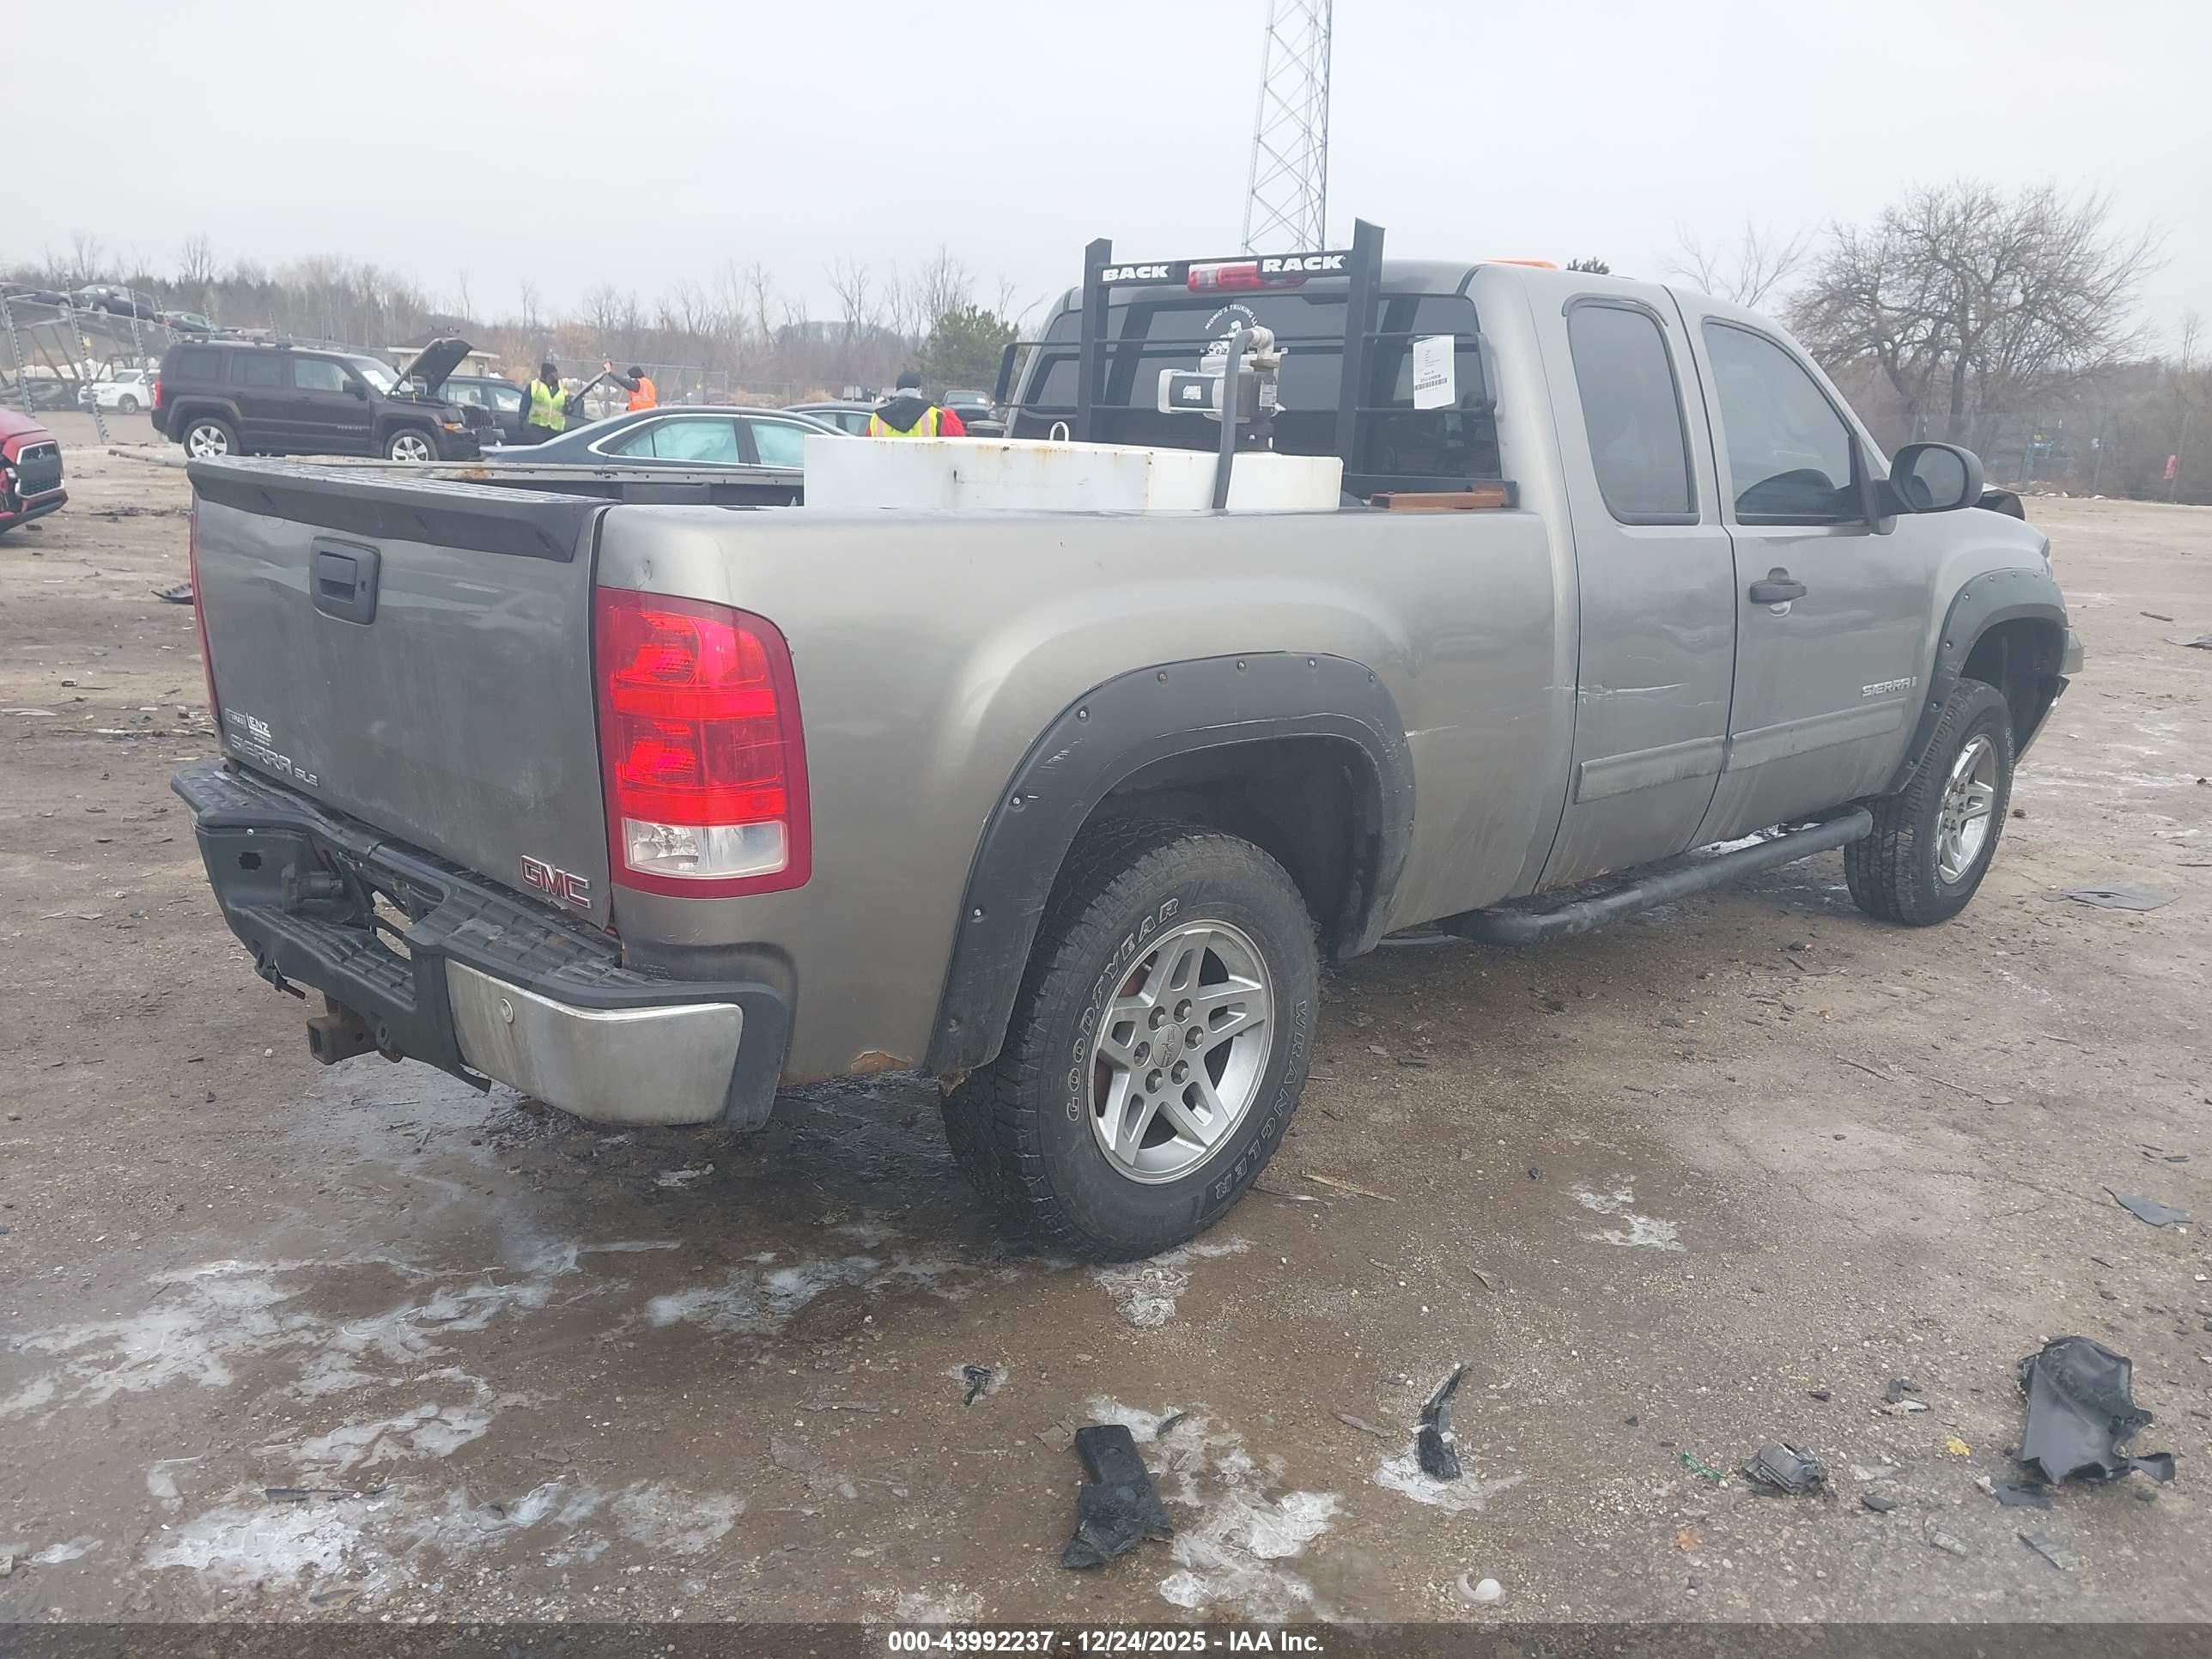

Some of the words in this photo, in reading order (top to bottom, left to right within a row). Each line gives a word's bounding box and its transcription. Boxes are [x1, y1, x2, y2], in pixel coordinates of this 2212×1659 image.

[1102, 265, 1169, 282] BACK
[1262, 255, 1344, 272] RACK
[1862, 678, 1911, 697] SIERRA
[246, 712, 271, 738] LENZ
[229, 733, 293, 775] SIERRA
[294, 767, 319, 787] SLE
[520, 854, 592, 909] GMC
[1066, 897, 1179, 1121] GOODYEAR
[1215, 999, 1307, 1200] WRANGLER
